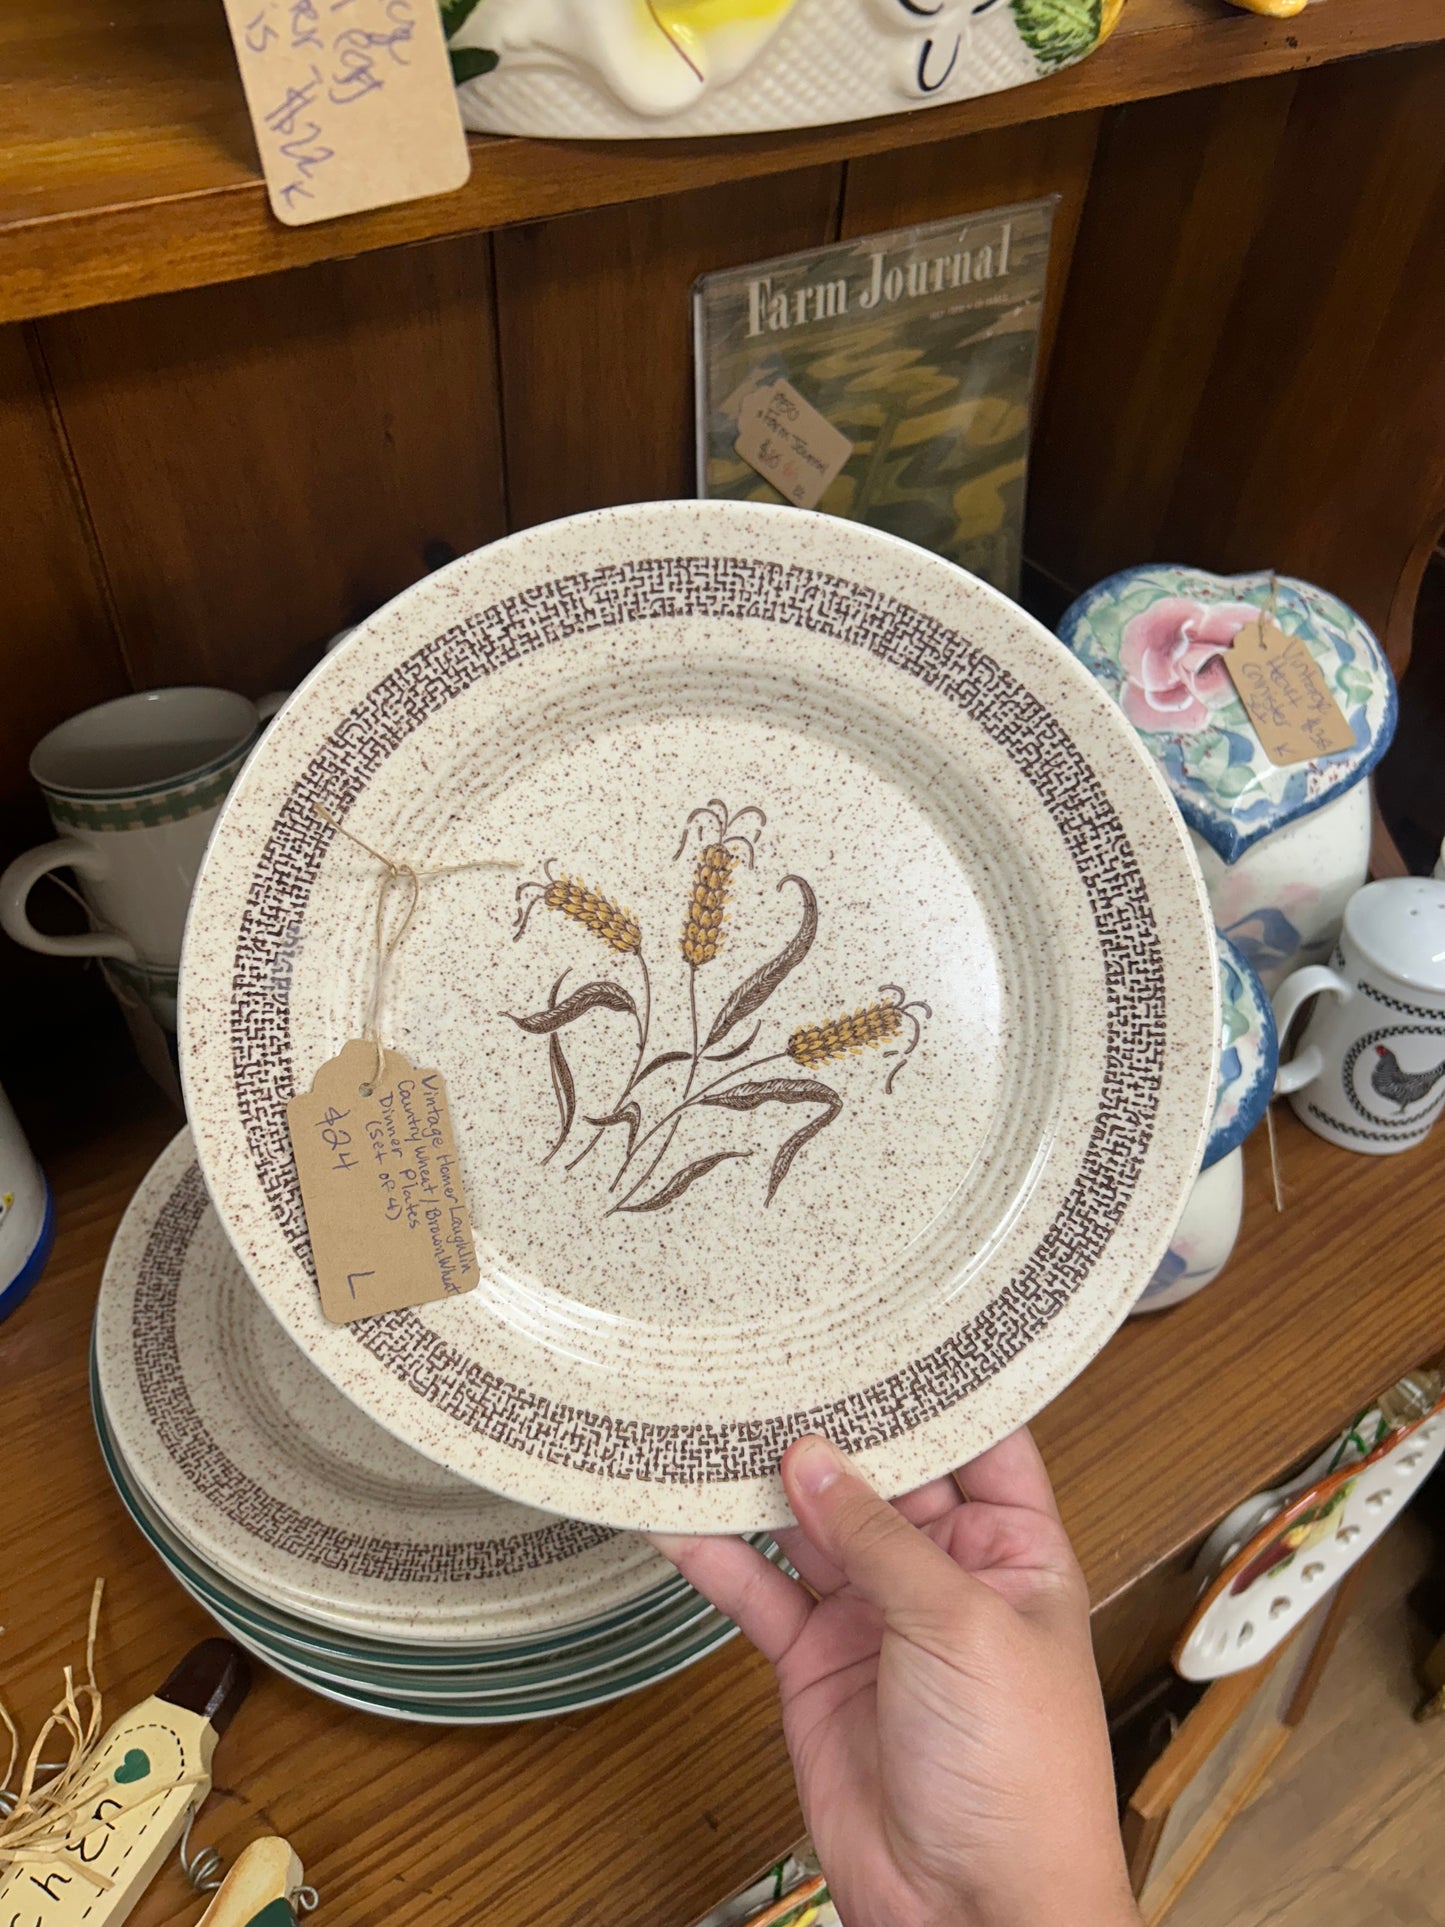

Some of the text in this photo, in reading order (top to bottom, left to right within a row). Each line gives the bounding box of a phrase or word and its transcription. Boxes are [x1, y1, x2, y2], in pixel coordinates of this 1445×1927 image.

[744, 223, 1012, 338] Farm Journal
[315, 1106, 359, 1171] $24
[397, 1080, 423, 1142] Country
[378, 1172, 396, 1193] of
[379, 1091, 421, 1229] Dinner Plates
[421, 1074, 475, 1274] Vintage Homer Laughlin
[384, 1197, 403, 1221] 4)
[346, 1270, 375, 1300] L
